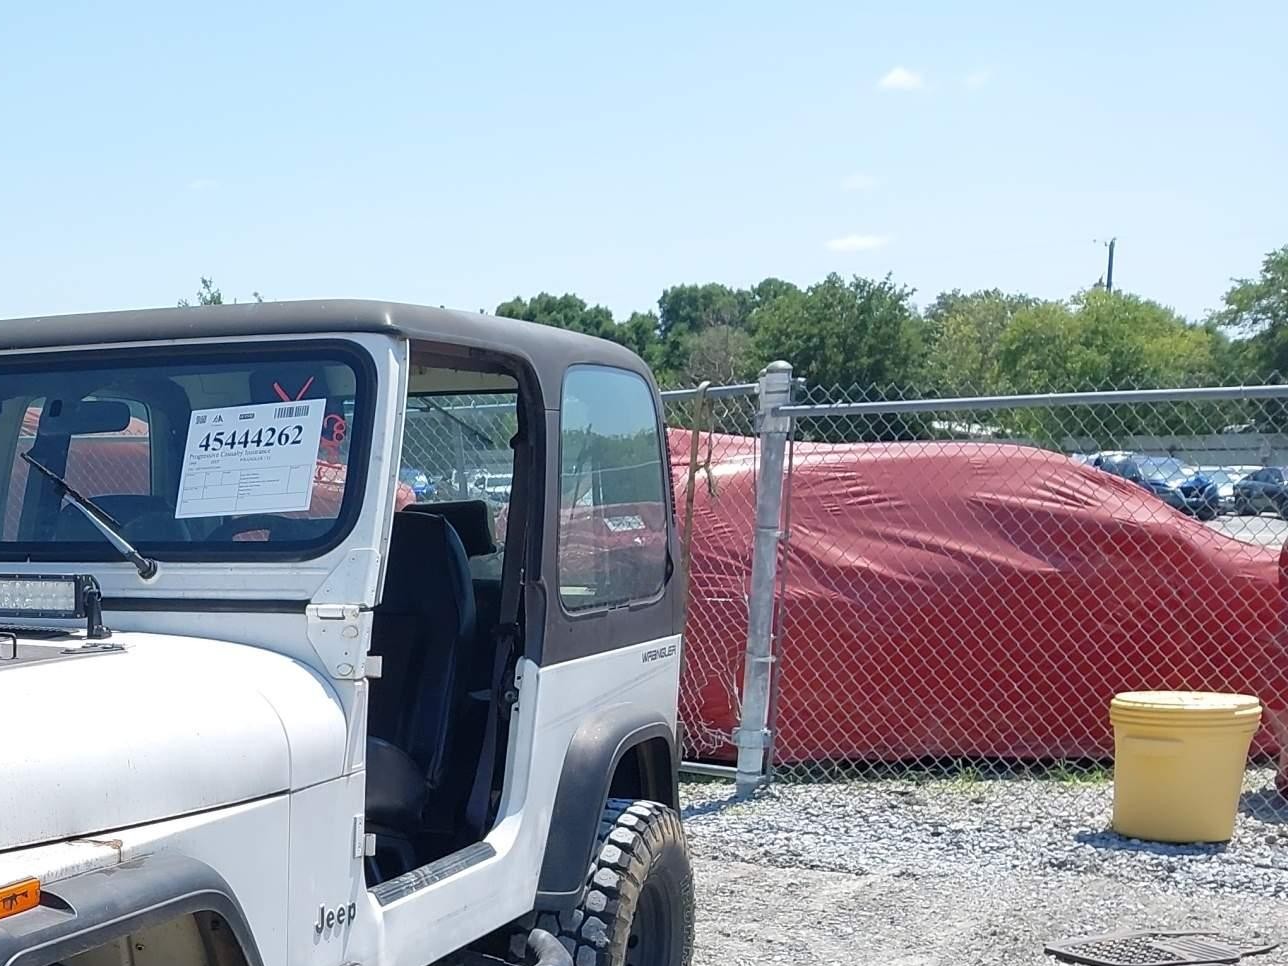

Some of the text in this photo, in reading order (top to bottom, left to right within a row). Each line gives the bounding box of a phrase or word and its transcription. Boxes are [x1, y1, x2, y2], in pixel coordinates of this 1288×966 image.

[199, 425, 303, 452] 45444262
[641, 644, 676, 662] WRANGLER
[315, 902, 357, 934] Jeep
